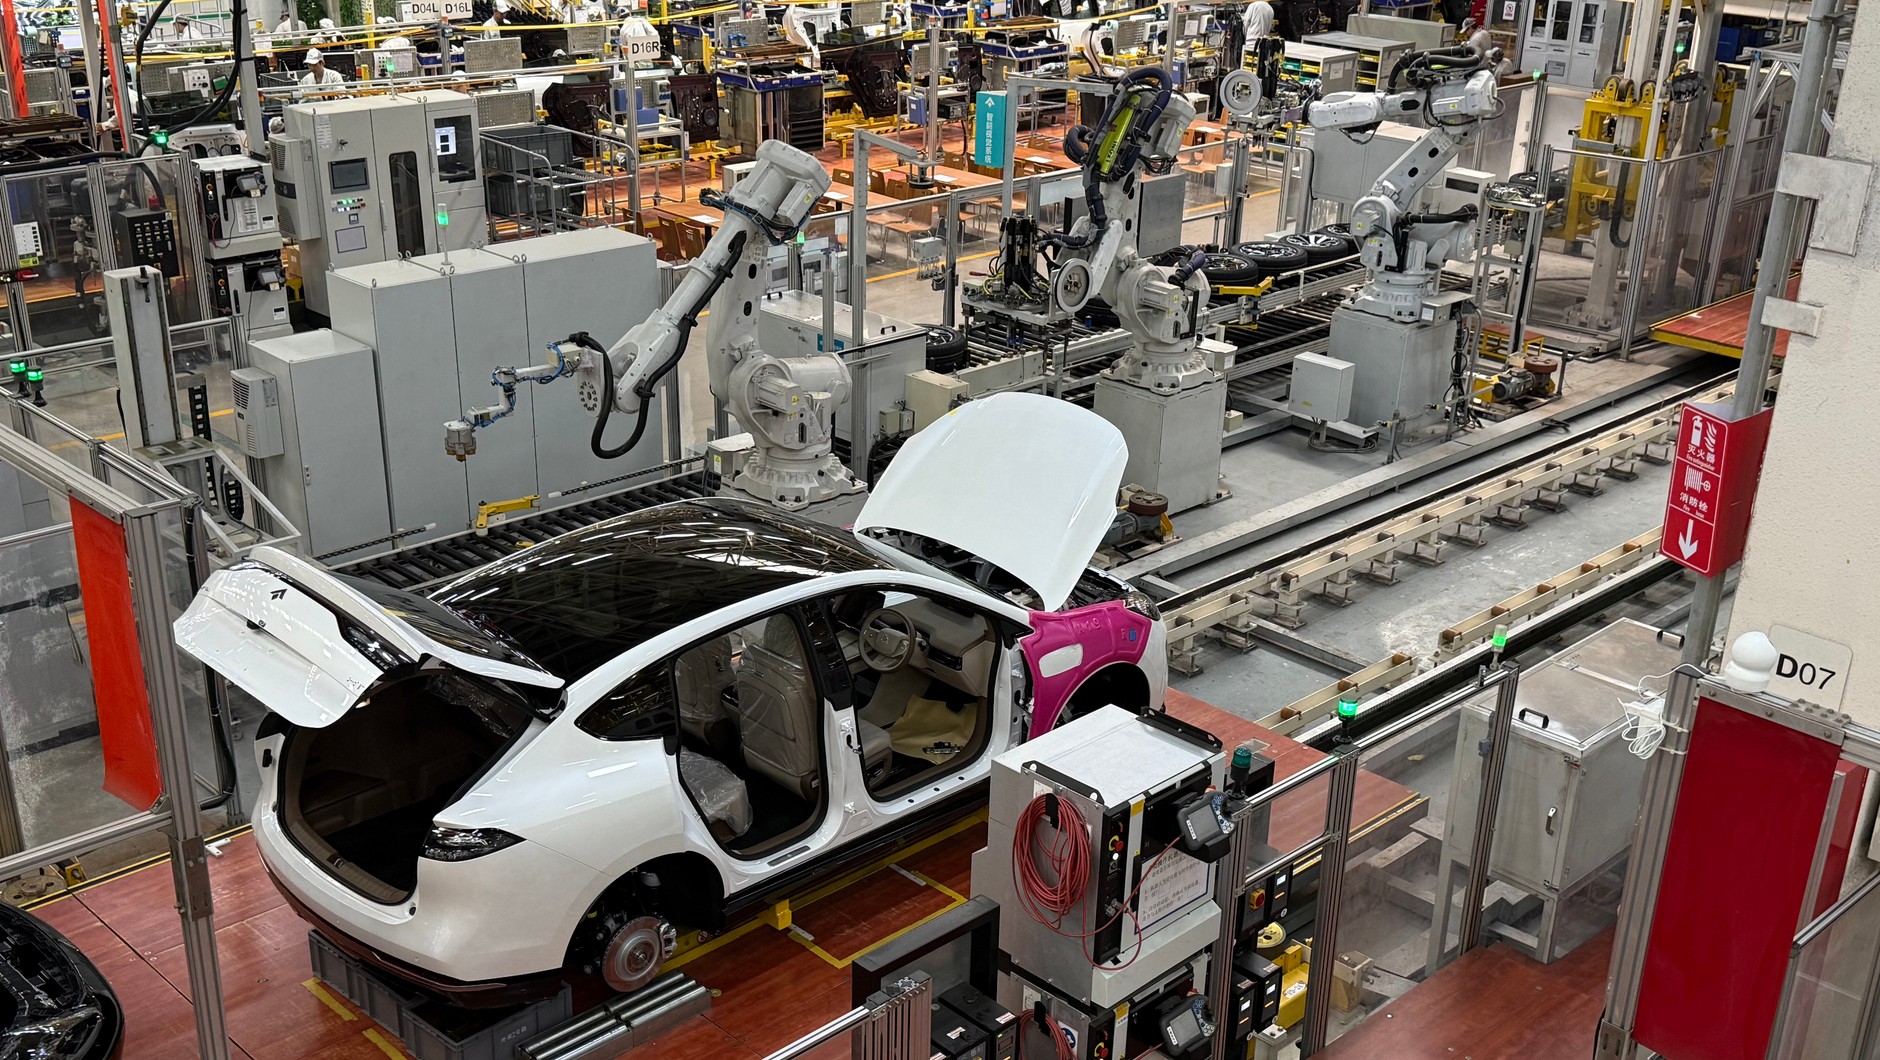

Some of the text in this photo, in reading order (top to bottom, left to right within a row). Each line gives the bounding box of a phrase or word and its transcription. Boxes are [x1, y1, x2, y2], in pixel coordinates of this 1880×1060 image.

[412, 3, 439, 14] D04L
[445, 2, 472, 14] D16L
[632, 41, 660, 54] D16R
[1687, 443, 1716, 465] 灭火器
[1679, 492, 1708, 513] 消防栓
[1683, 504, 1705, 519] Fire hose
[1776, 653, 1836, 690] D07
